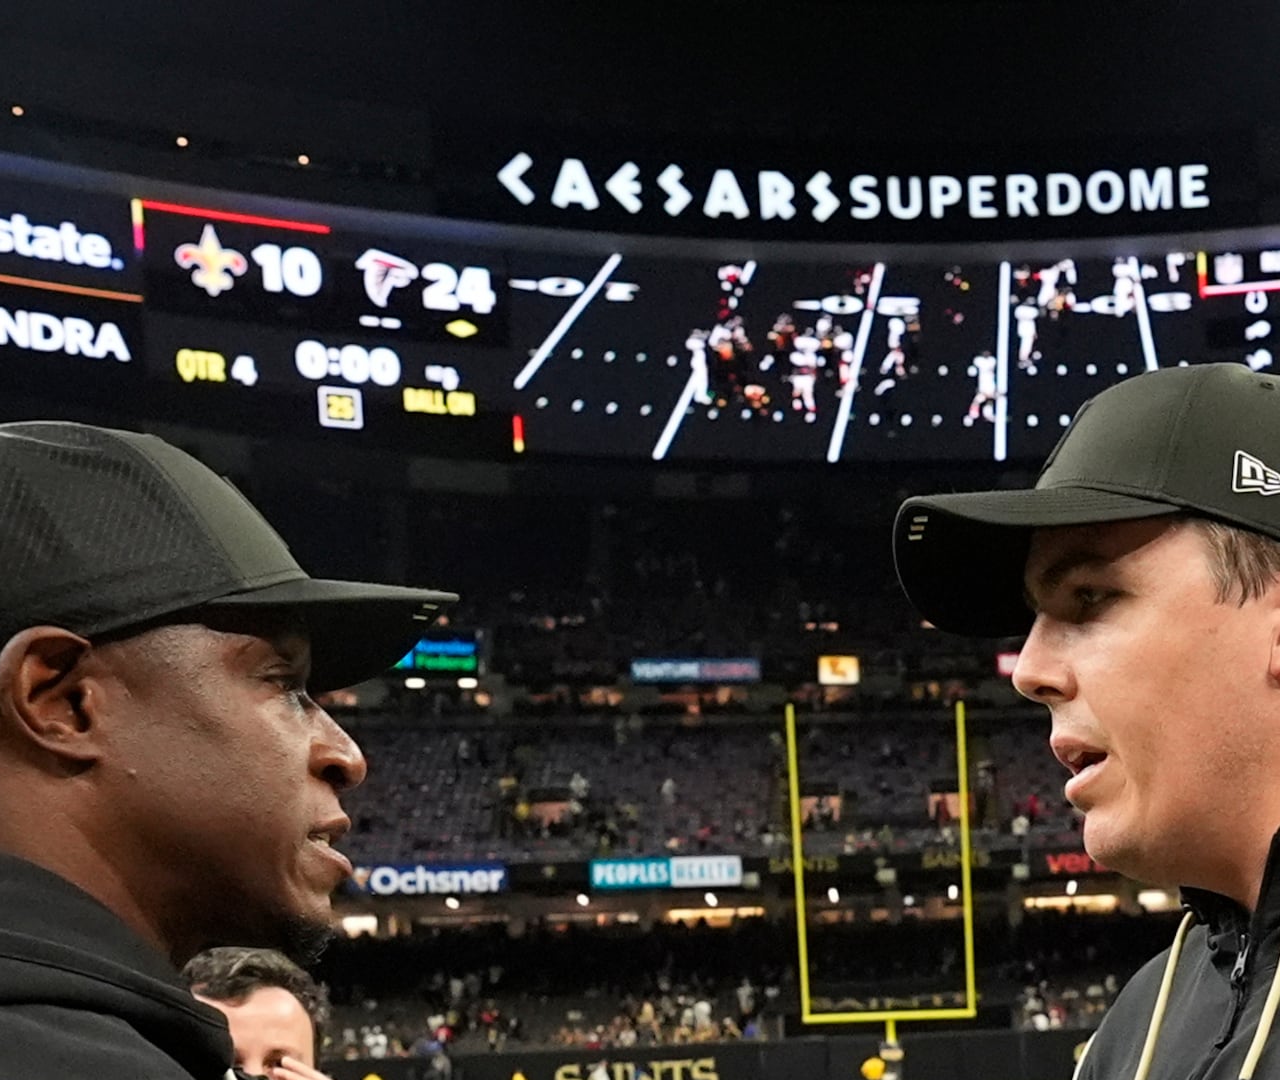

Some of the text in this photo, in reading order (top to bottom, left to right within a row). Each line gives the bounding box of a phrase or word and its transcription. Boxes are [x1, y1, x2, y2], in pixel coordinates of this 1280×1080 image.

[497, 152, 1210, 222] CAESARS SUPERDOME
[251, 243, 322, 297] 10
[422, 262, 497, 314] 24
[176, 348, 259, 386] QTR 4
[294, 340, 402, 387] 0:00
[370, 866, 505, 895] Ochsner
[593, 861, 670, 885] PEOPLES
